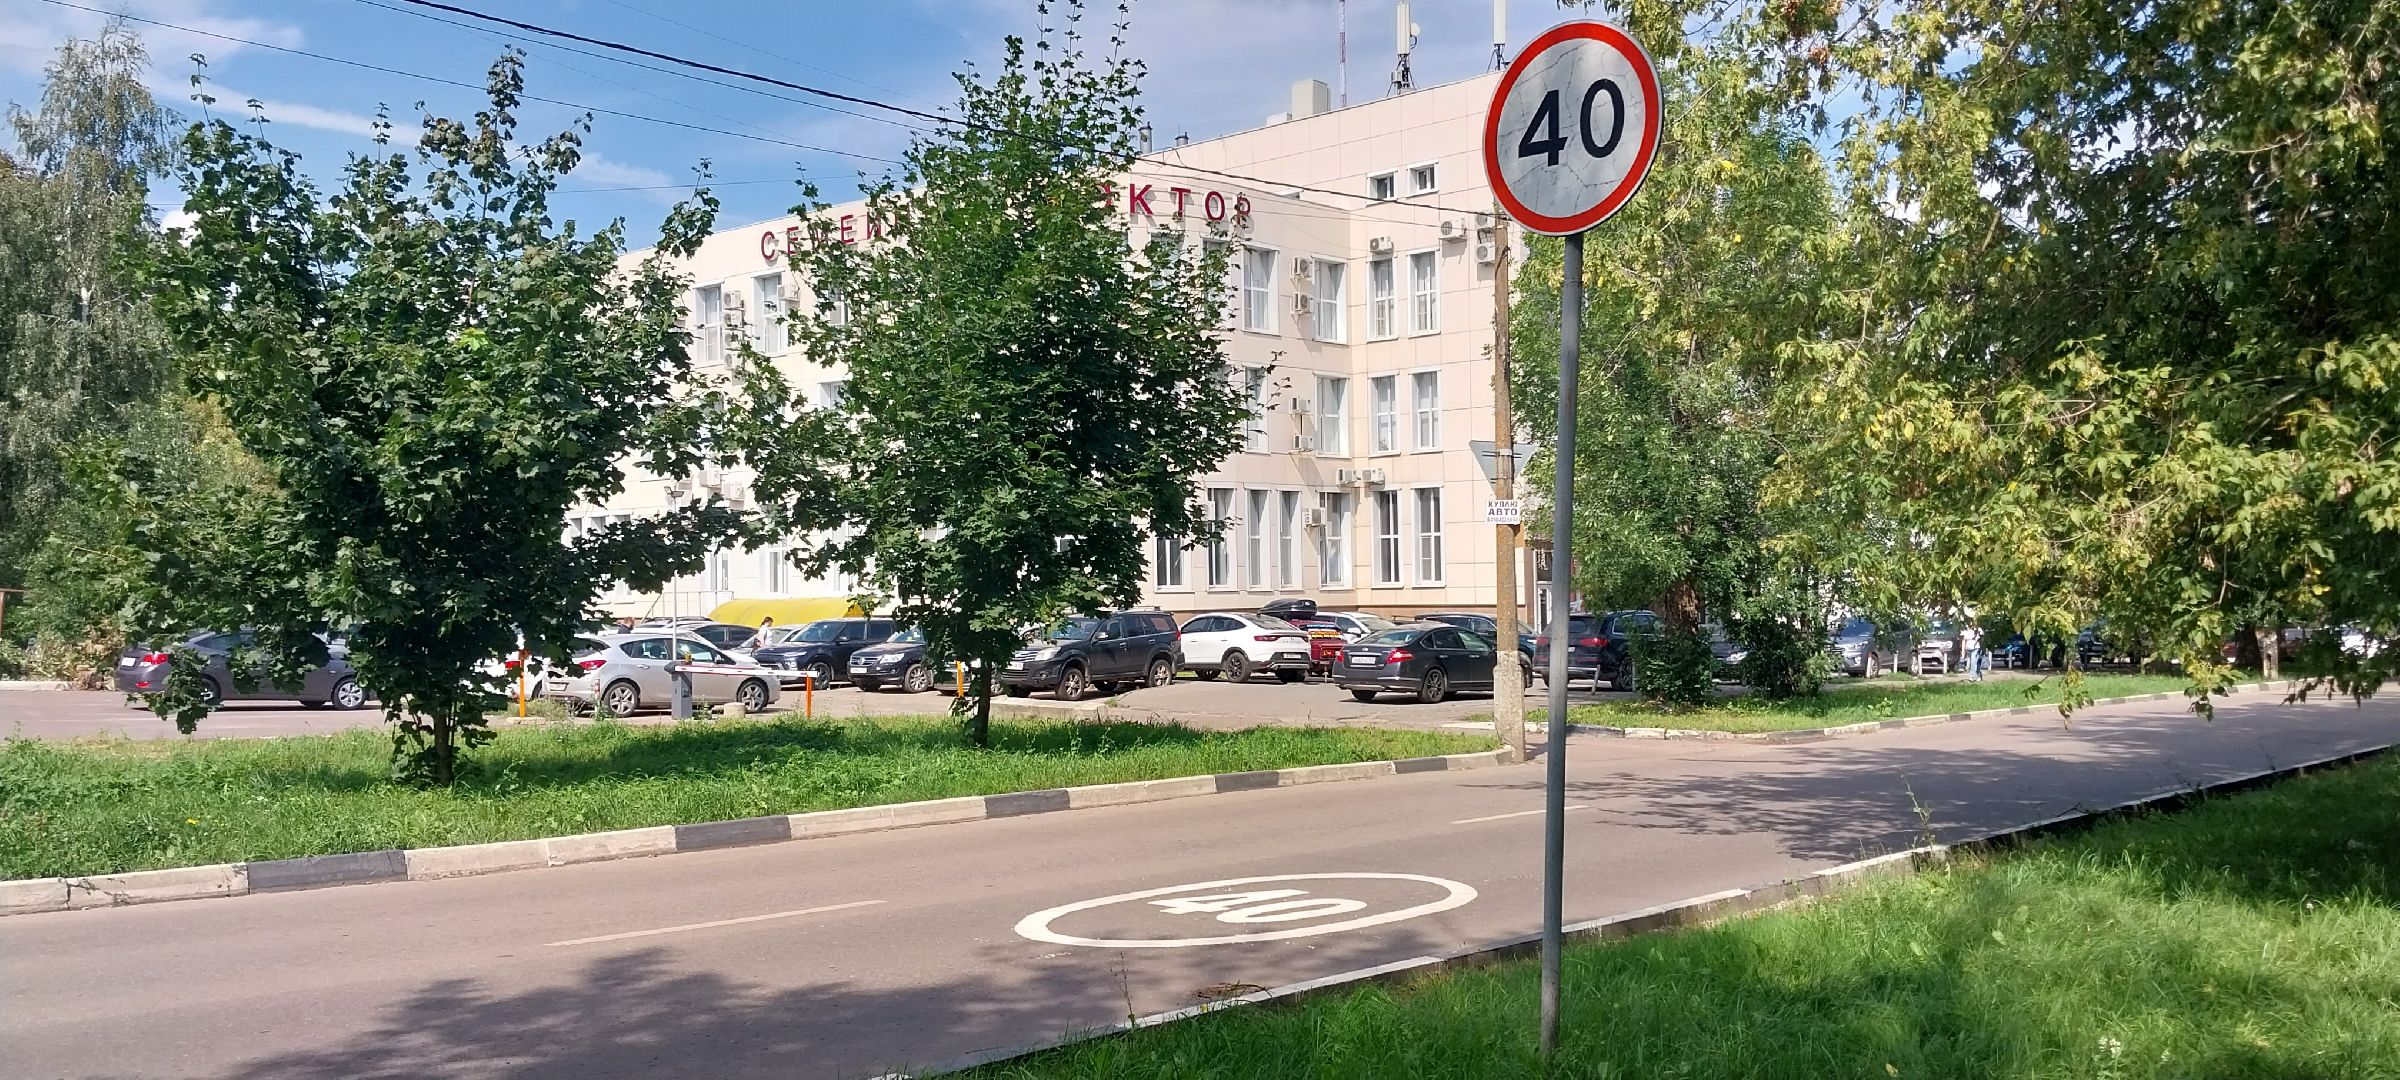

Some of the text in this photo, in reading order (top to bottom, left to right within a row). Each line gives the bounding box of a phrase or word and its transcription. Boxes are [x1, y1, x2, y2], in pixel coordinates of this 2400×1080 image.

[1518, 78, 1625, 167] 40
[1488, 508, 1518, 516] АВТО
[1147, 889, 1368, 923] 40
